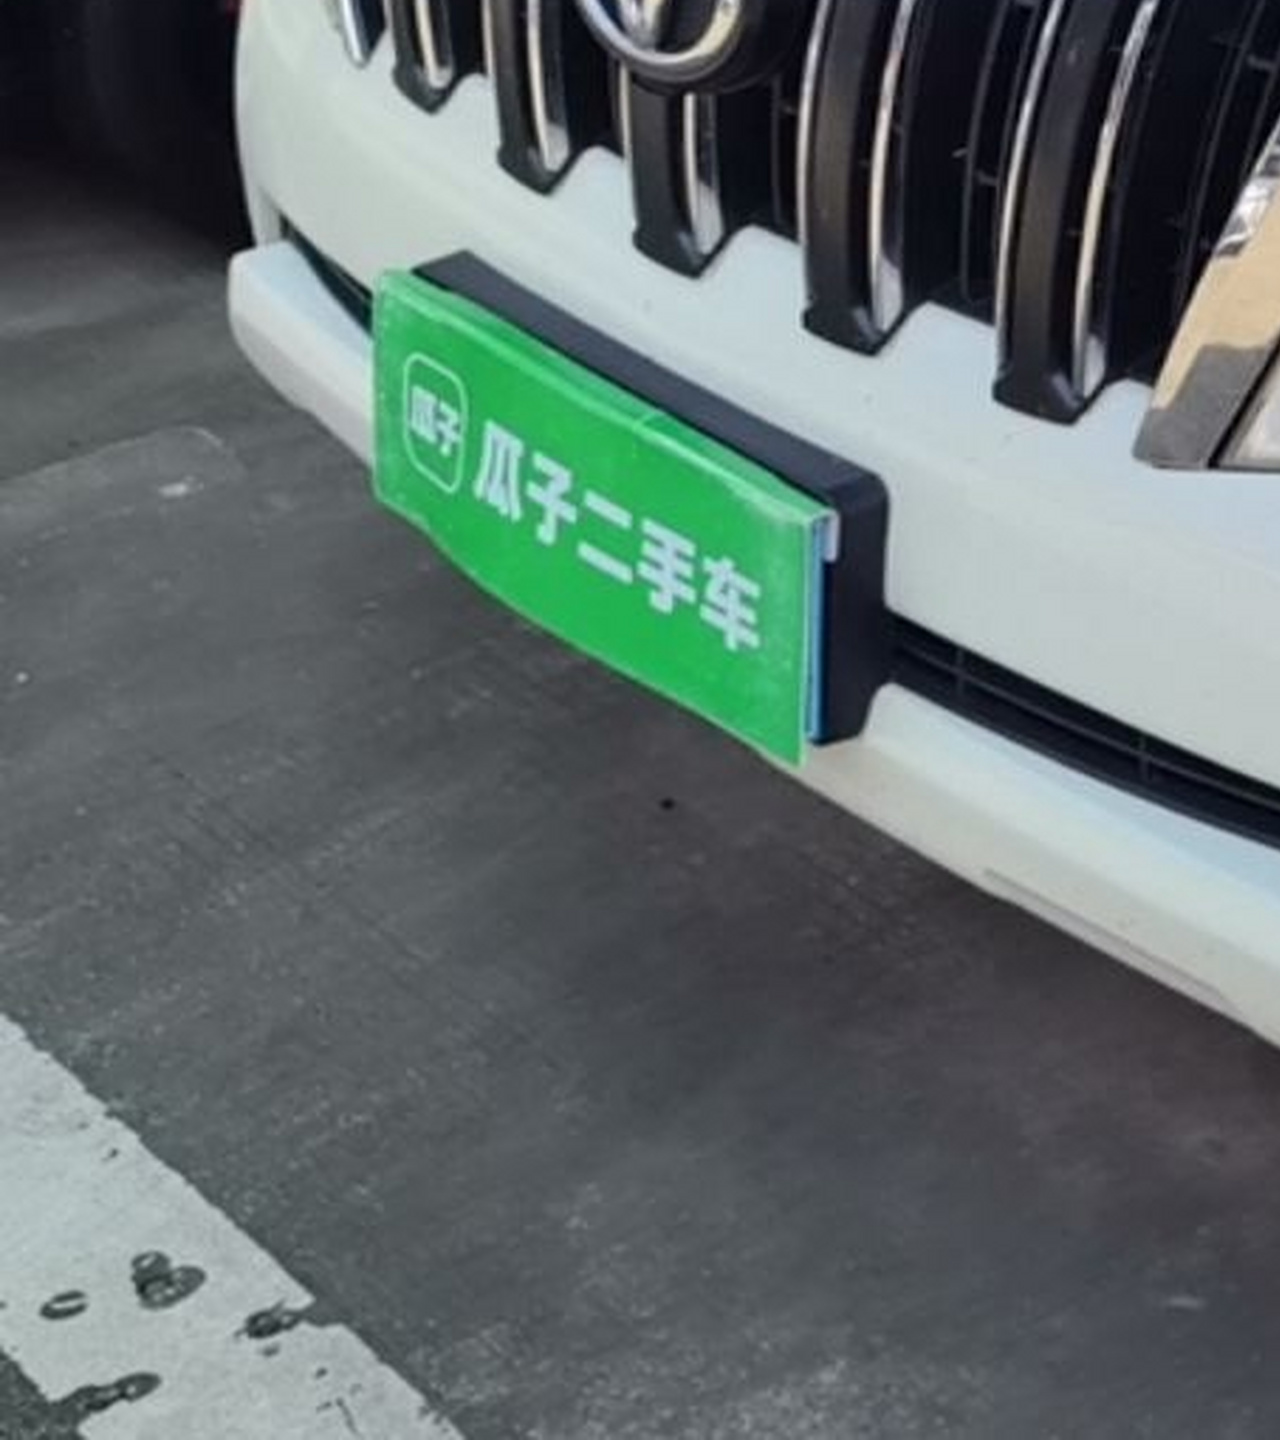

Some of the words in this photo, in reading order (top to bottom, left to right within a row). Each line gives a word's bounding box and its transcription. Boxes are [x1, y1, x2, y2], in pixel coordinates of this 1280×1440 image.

[473, 420, 760, 651] 瓜子二手车
